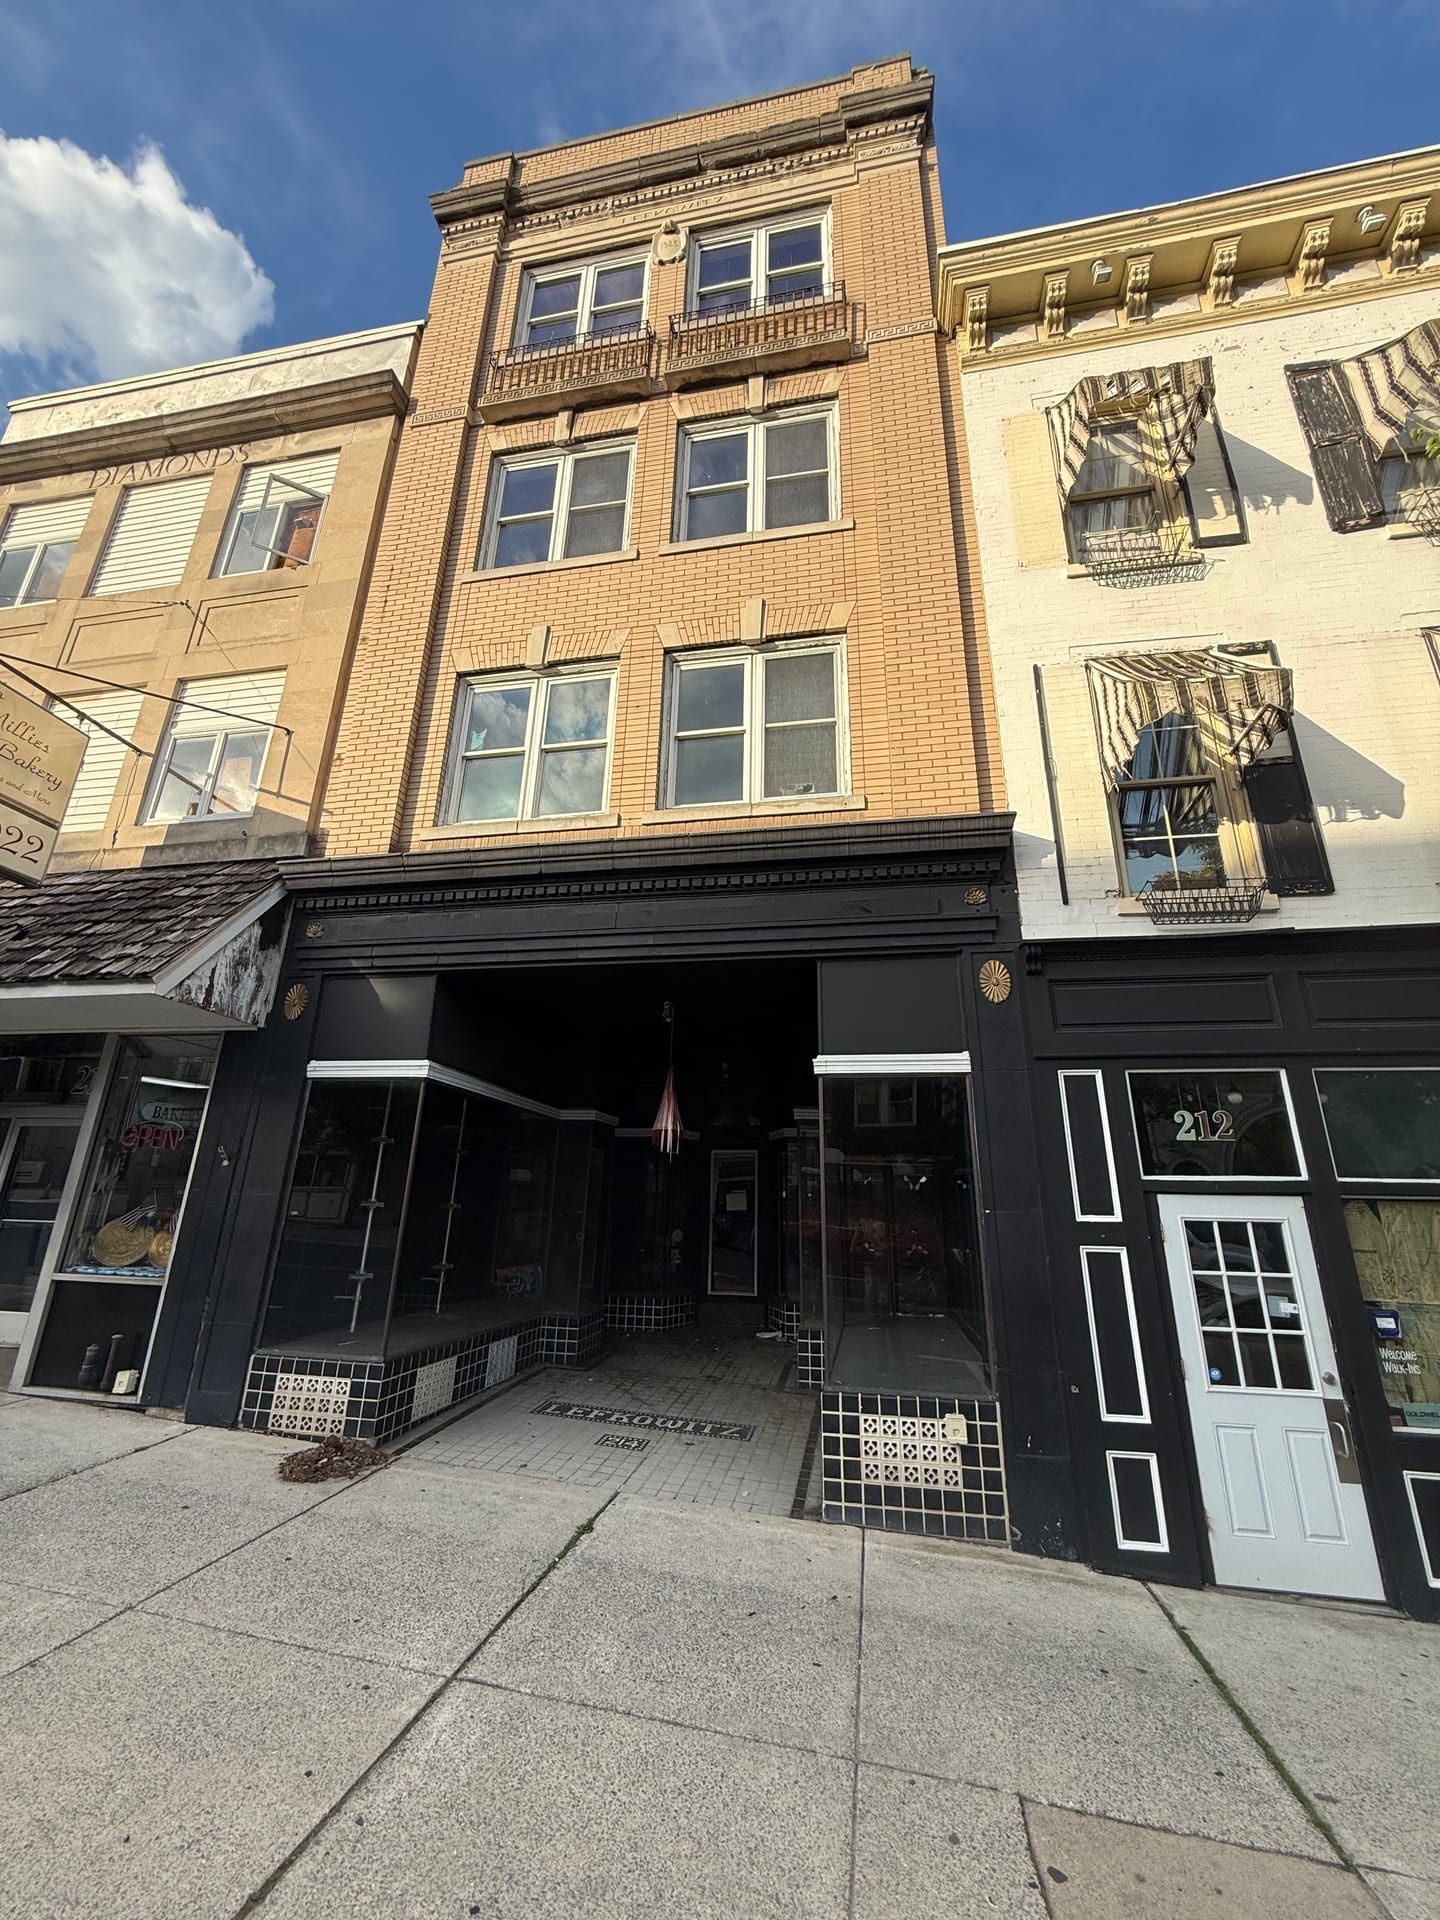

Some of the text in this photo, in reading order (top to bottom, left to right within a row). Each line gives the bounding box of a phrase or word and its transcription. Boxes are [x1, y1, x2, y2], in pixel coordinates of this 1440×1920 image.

[89, 443, 250, 488] DIAMONDS
[0, 738, 62, 791] Bakery
[23, 789, 51, 806] More
[0, 824, 44, 864] 22
[122, 1126, 182, 1151] OPEN
[1174, 1110, 1236, 1141] 212
[547, 1403, 744, 1437] LEFKOWITZ
[603, 1436, 641, 1448] 214
